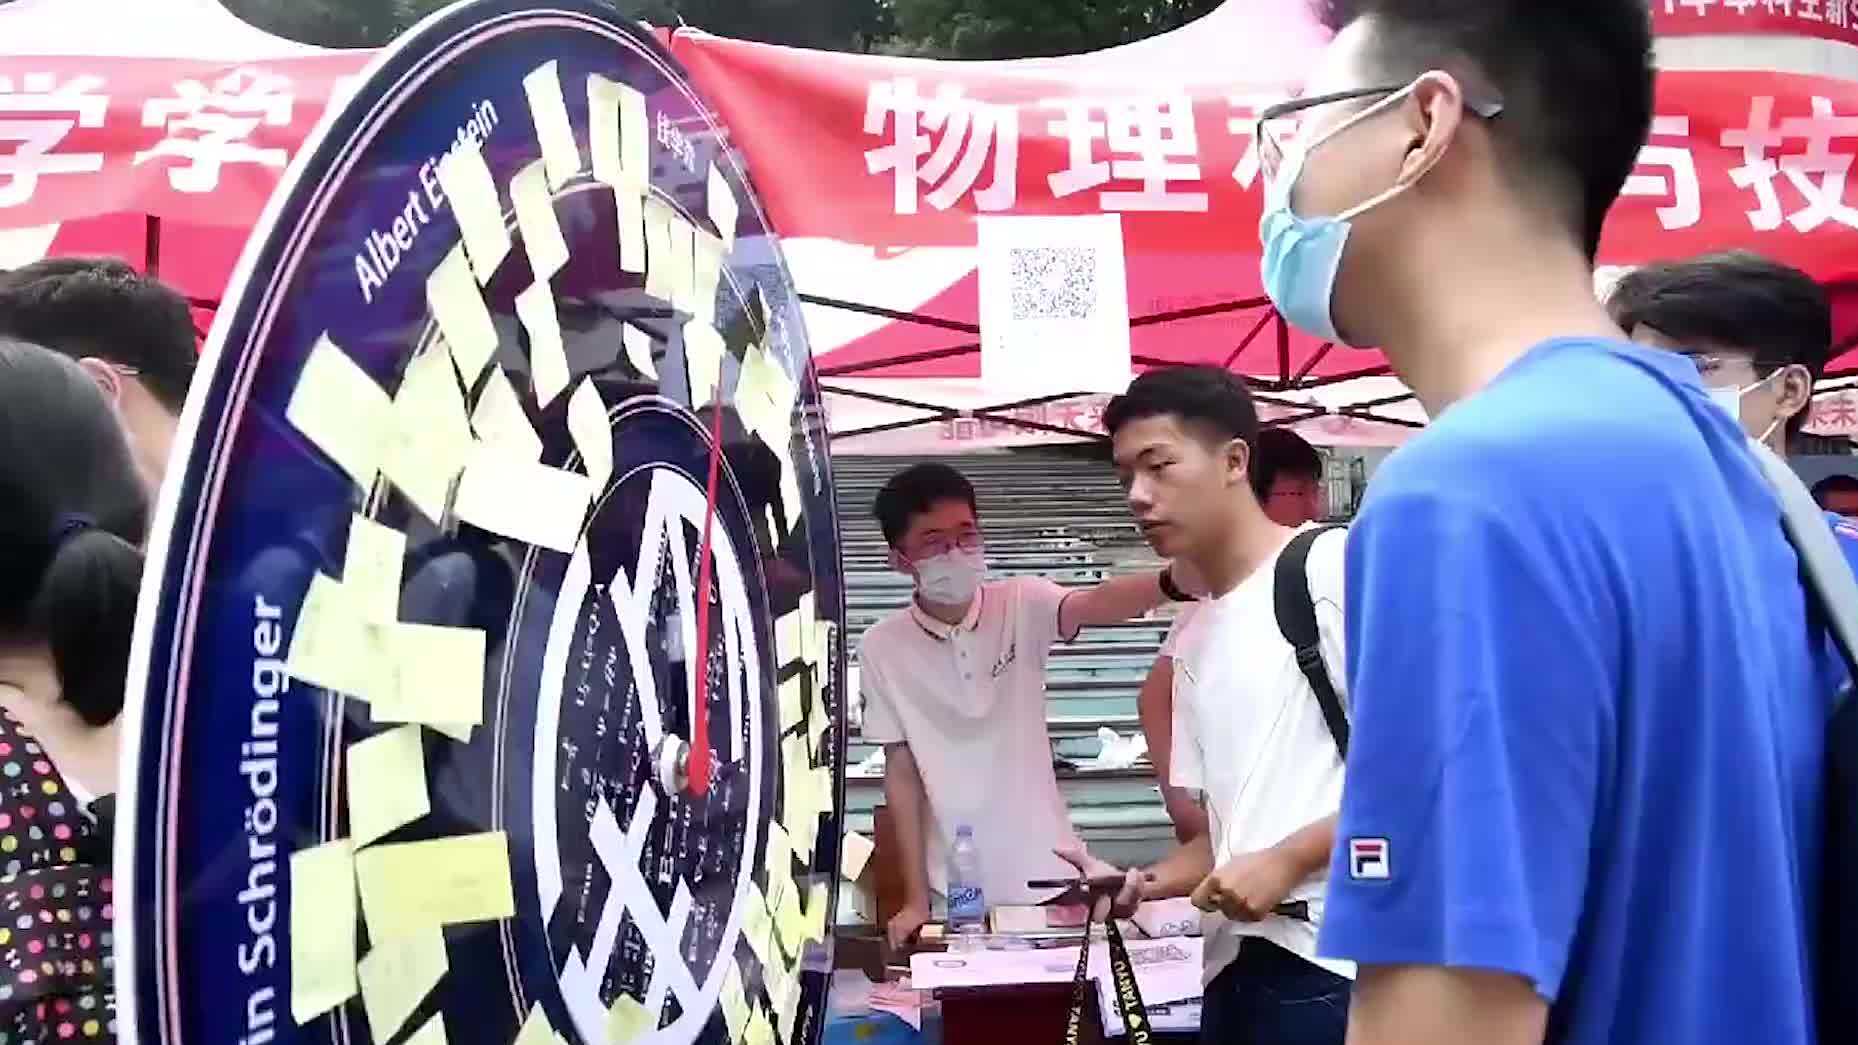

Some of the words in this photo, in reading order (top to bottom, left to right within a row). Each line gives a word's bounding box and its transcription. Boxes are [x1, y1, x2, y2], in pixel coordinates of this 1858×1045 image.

[0, 67, 357, 208] 学学
[354, 189, 430, 305] Albert
[418, 99, 500, 211] Etein
[237, 593, 290, 976] Schrödinger
